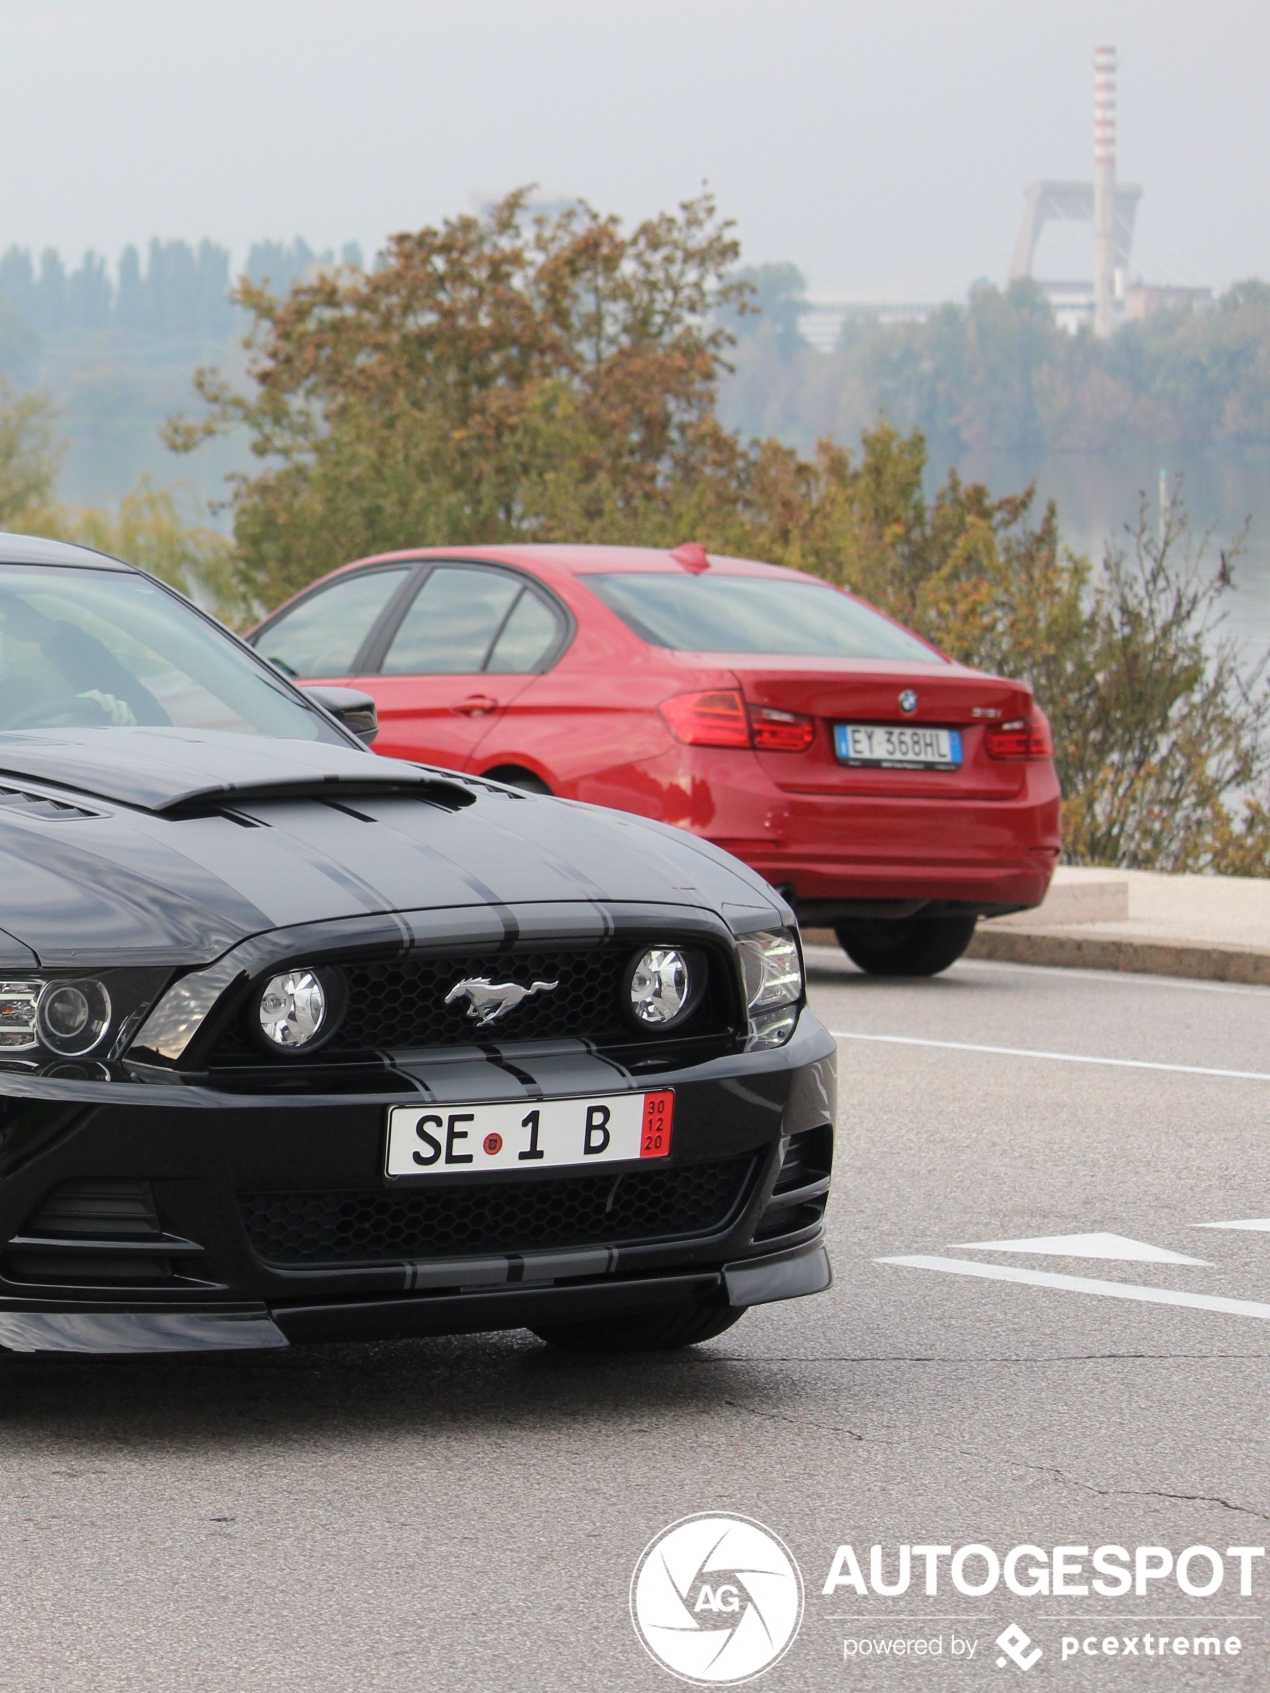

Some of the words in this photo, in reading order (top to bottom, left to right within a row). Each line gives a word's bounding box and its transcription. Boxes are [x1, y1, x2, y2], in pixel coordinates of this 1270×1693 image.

[851, 729, 875, 754] EY
[884, 731, 948, 758] 368HL
[648, 1099, 665, 1114] 30
[648, 1117, 664, 1132] 12
[412, 1113, 475, 1166] SE
[518, 1110, 544, 1160] 1
[583, 1105, 611, 1155] B
[644, 1135, 662, 1150] 20
